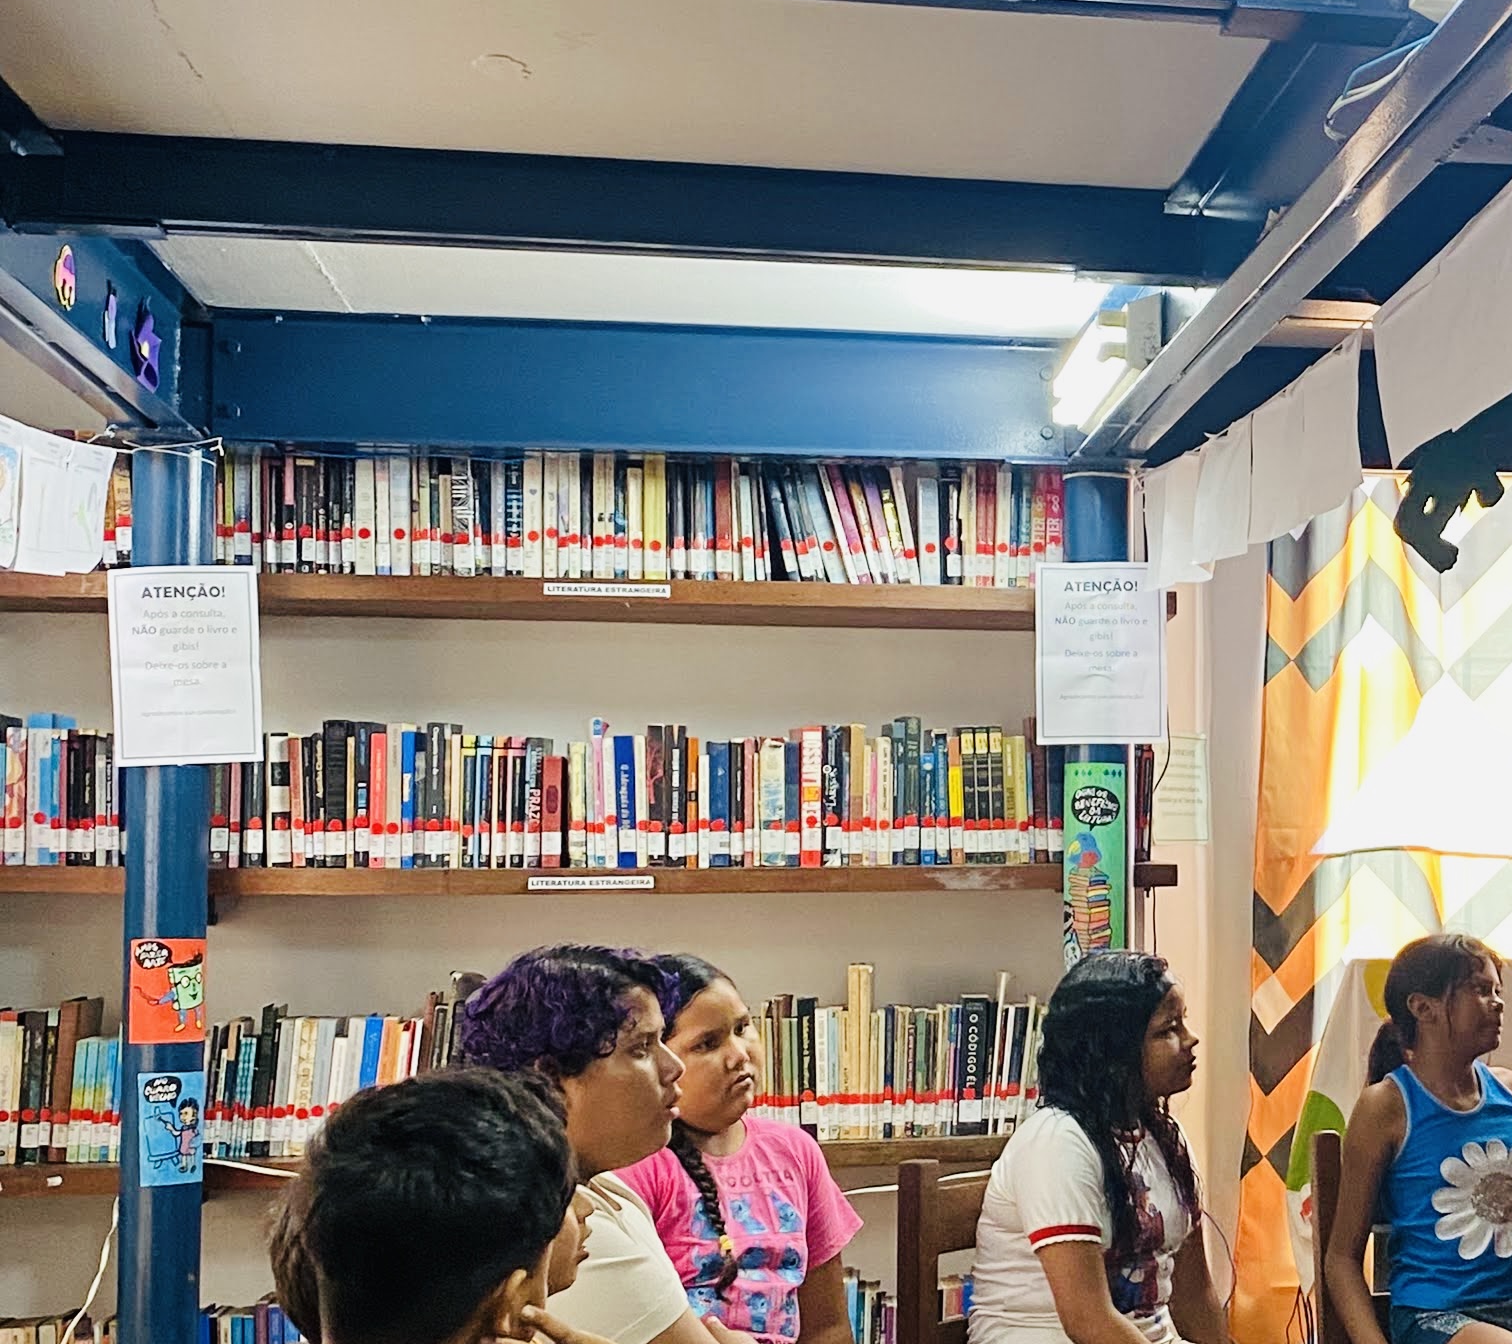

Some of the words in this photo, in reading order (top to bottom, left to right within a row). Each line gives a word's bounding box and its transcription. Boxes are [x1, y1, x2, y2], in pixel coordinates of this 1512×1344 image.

[141, 583, 225, 601] ATENÇÃO!
[1064, 578, 1138, 594] ATENÇÃO!
[1055, 615, 1076, 625] NÃO
[132, 624, 157, 635] NÃO
[159, 626, 195, 636] guarde
[206, 625, 229, 634] livro
[969, 1014, 978, 1023] O
[967, 1026, 979, 1073] CÓDIGO
[966, 1076, 977, 1088] ÉL
